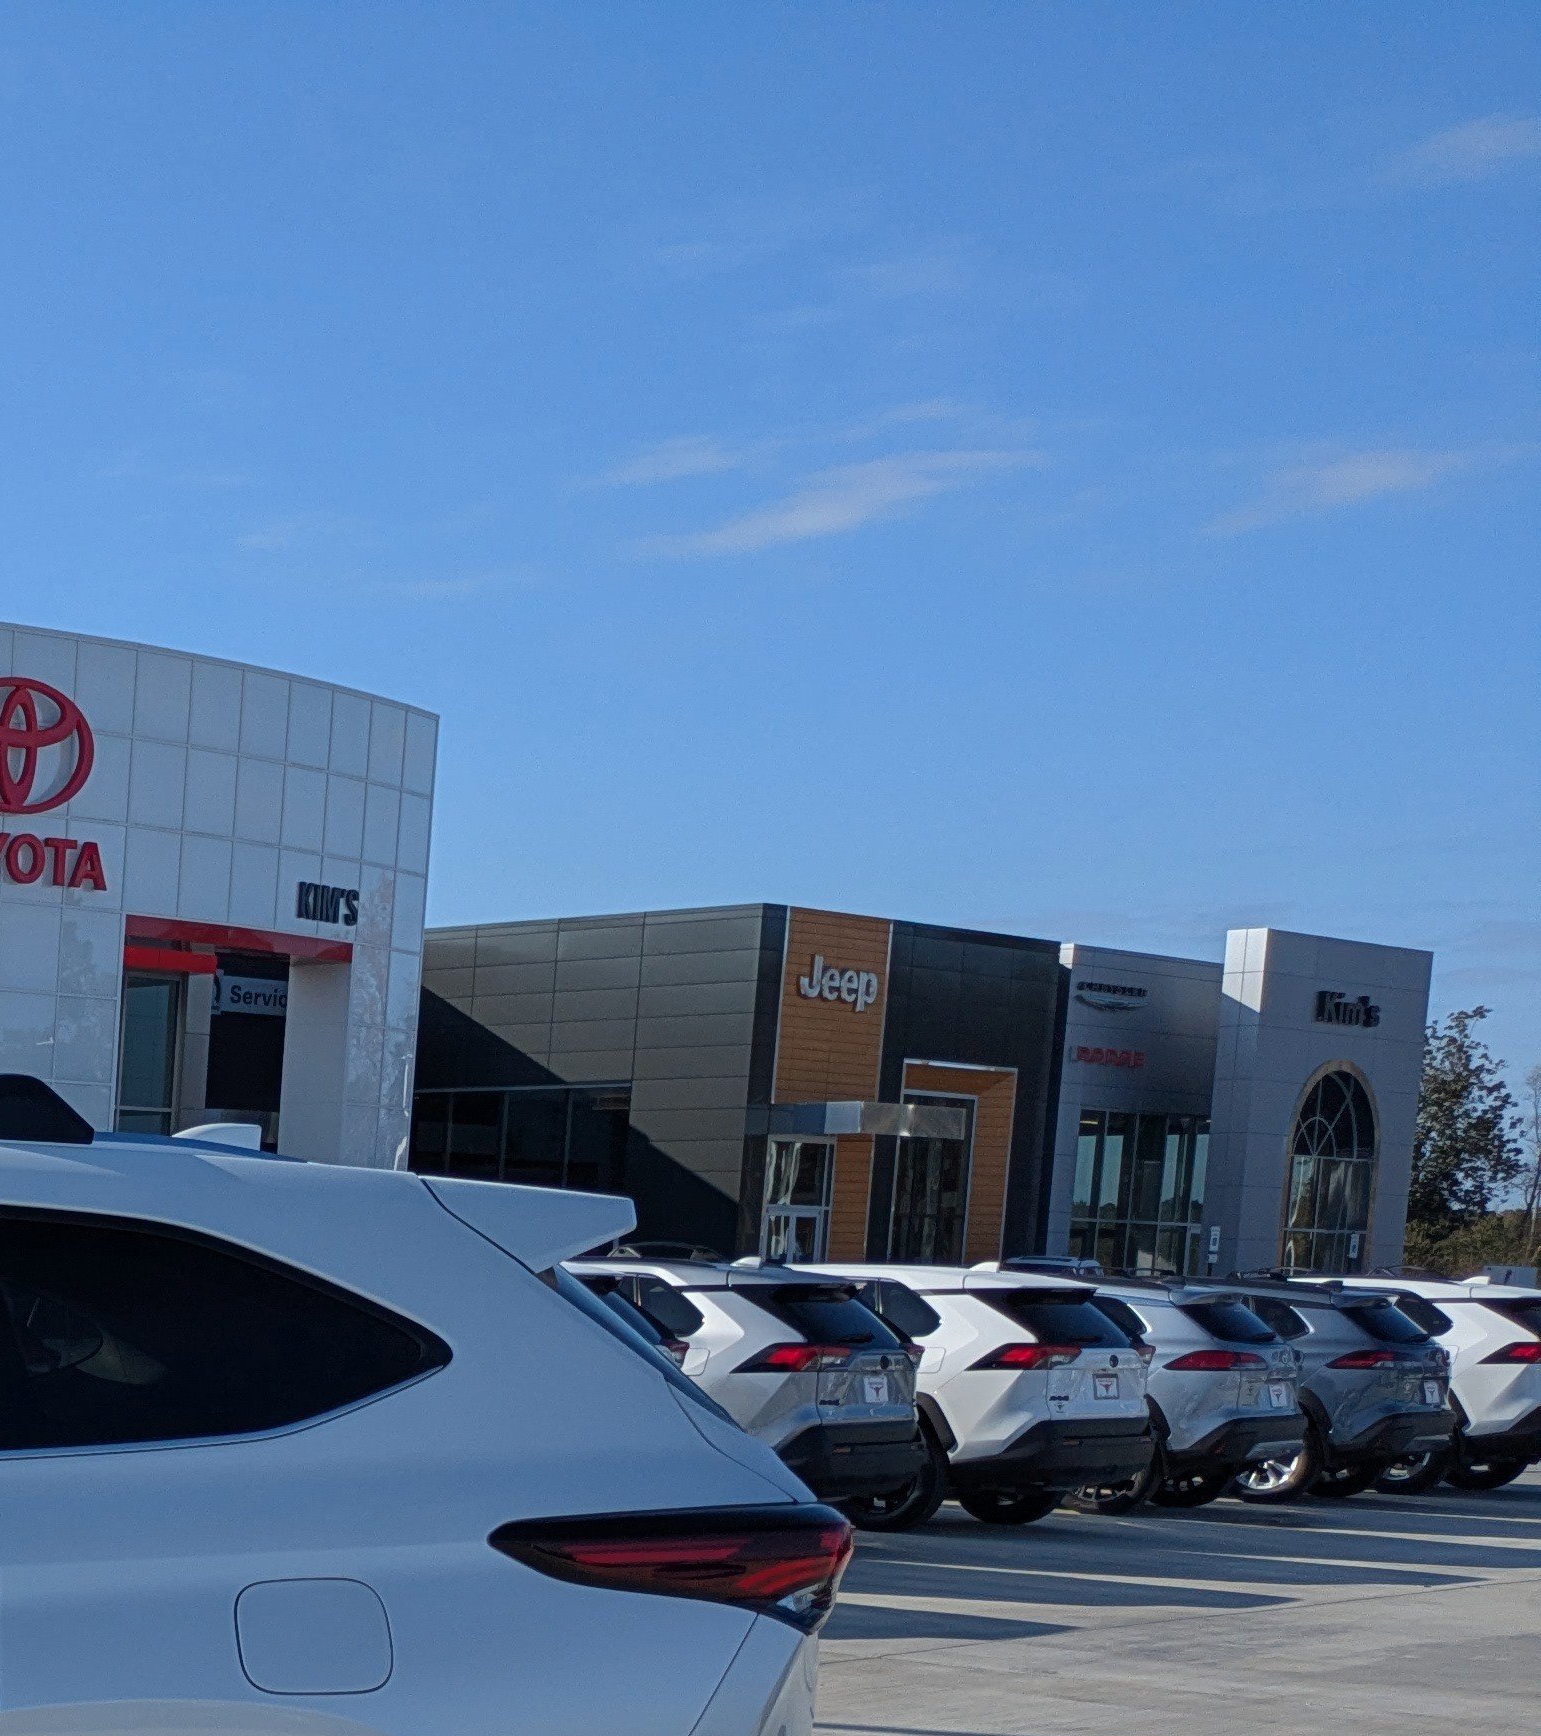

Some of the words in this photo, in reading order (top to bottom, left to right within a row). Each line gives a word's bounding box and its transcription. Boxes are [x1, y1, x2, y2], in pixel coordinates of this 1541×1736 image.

[297, 881, 359, 926] KIM'S
[230, 985, 287, 1008] Servic
[800, 954, 878, 1012] Jeep
[1317, 991, 1381, 1027] Kim's
